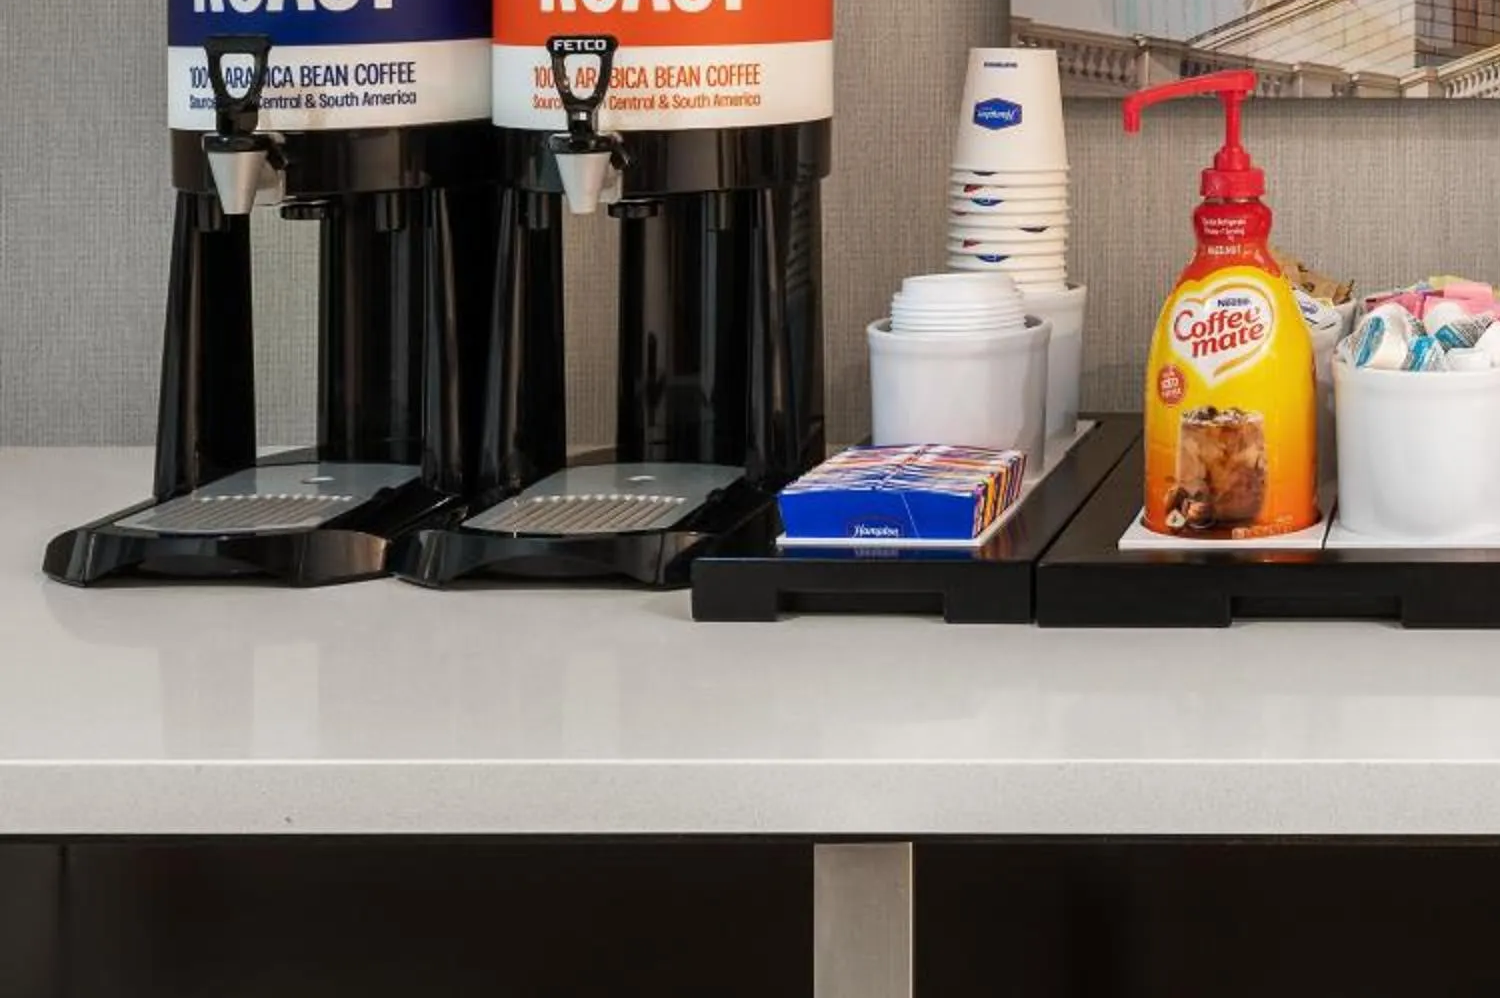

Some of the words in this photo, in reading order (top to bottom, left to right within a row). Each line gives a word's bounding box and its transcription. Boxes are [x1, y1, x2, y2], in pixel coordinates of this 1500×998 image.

[553, 39, 607, 51] FETCO
[225, 66, 295, 89] ARAICA
[300, 64, 349, 87] BEAN
[354, 61, 417, 85] COFFEE
[533, 66, 569, 89] 100
[575, 65, 649, 89] ARBICA
[654, 64, 701, 89] BEAN
[706, 62, 761, 86] COFFEE
[305, 93, 317, 109] &
[319, 91, 359, 109] South
[362, 88, 417, 106] America
[609, 94, 656, 111] Central
[659, 93, 670, 109] &
[672, 92, 711, 109] South
[714, 90, 761, 107] America
[1175, 308, 1261, 342] Coffee
[1192, 323, 1265, 358] mate
